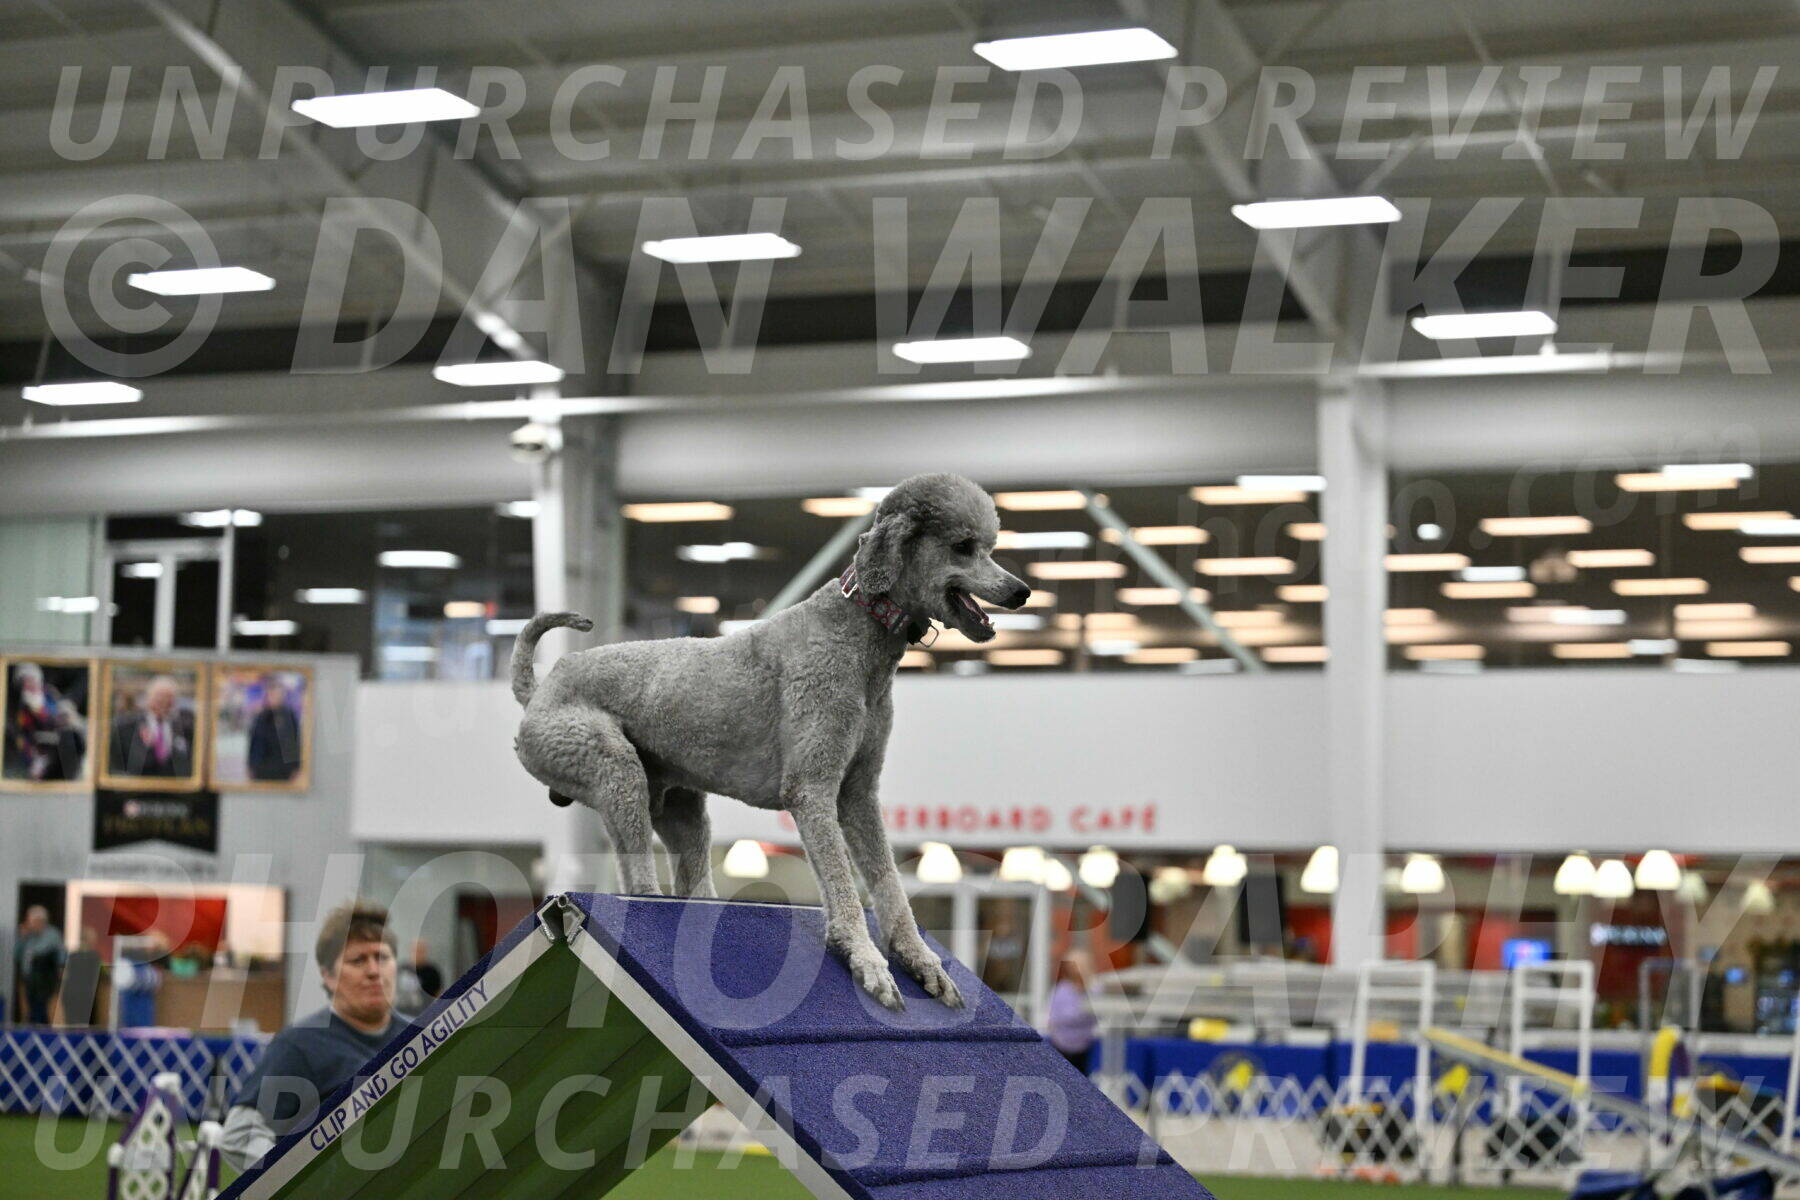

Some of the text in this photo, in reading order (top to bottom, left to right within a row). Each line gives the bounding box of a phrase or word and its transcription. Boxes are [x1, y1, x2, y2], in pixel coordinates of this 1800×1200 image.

[778, 799, 1157, 833] CERBOARD CAFÉ
[310, 979, 489, 1151] CLIP AND GO AGILITY
